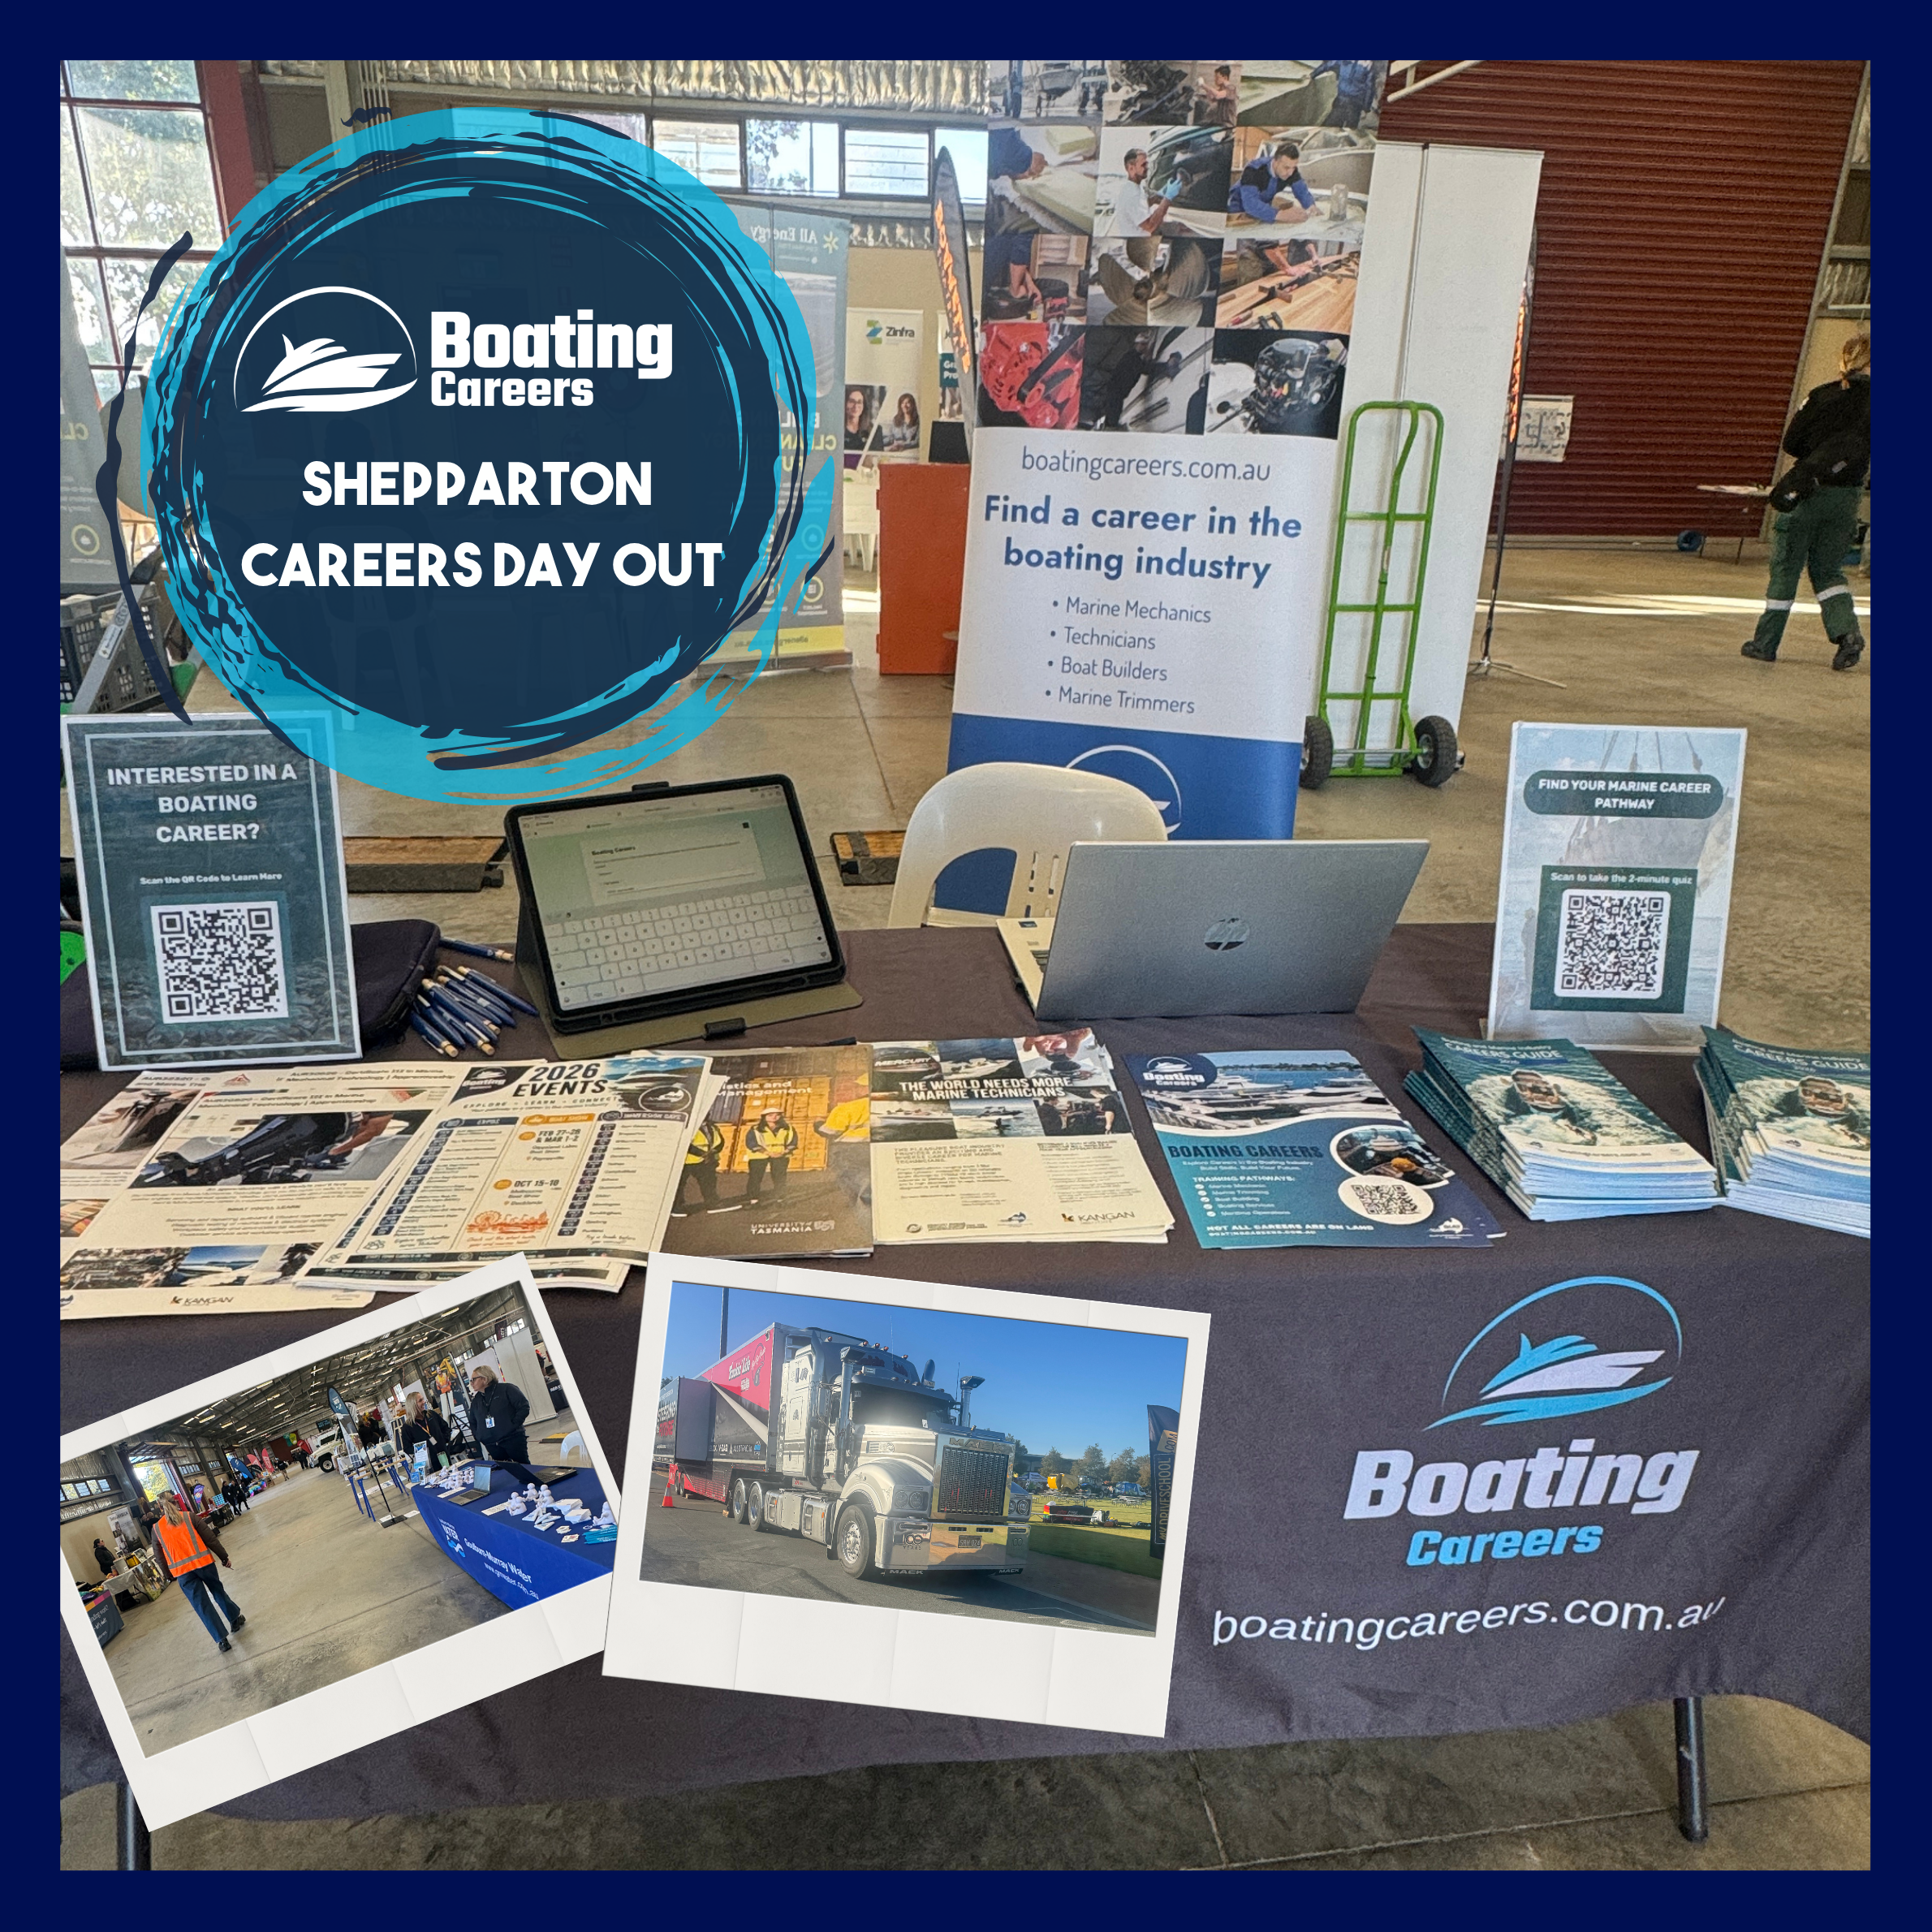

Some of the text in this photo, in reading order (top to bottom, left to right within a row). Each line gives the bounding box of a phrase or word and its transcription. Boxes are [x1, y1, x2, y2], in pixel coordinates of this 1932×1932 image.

[885, 326, 916, 338] Zinfra
[1021, 445, 1271, 481] boatingcareers.com.au
[984, 494, 1302, 539] Find a career in the
[1003, 536, 1272, 589] boating industry
[1066, 596, 1212, 623] Marine Mechanics
[1064, 626, 1156, 649] Technicians
[1060, 655, 1167, 682] Boat Builders
[1058, 685, 1196, 714] Marine Trimmers
[107, 763, 298, 786] INTERESTED IN A
[1538, 778, 1712, 795] FIND YOUR MARINE CAREER
[157, 794, 258, 813] BOATING
[1593, 797, 1656, 810] PATHWAY
[155, 822, 261, 843] CAREER?
[140, 873, 282, 886] Scan the QR Code to Learn More
[1550, 872, 1693, 886] Scan to take the 2-minute quiz
[1444, 1042, 1563, 1059] CAREERS GUIDE
[1733, 1044, 1871, 1071] CAREERS GUIDE
[874, 1056, 932, 1067] MERCURY
[528, 1063, 601, 1081] 2026
[1142, 1072, 1205, 1083] Boating
[512, 1079, 609, 1098] EVENTS
[722, 1080, 792, 1089] istics and
[899, 1076, 1073, 1092] THE WORLD NEEDS MORE
[912, 1087, 1066, 1101] MARINE TECHNICIANS
[1167, 1145, 1325, 1159] BOATING CAREERS
[1078, 1210, 1135, 1223] KANGAN
[750, 1226, 813, 1235] TASMANIA
[183, 1296, 234, 1305] KANGAN
[948, 1437, 1007, 1454] MACK
[1343, 1438, 1700, 1520] Boating
[1158, 1456, 1172, 1527] DRIVESCHOOL
[1405, 1524, 1603, 1568] Careers
[507, 1561, 533, 1584] Water
[1211, 1594, 1727, 1652] boatingcareers.com.au
